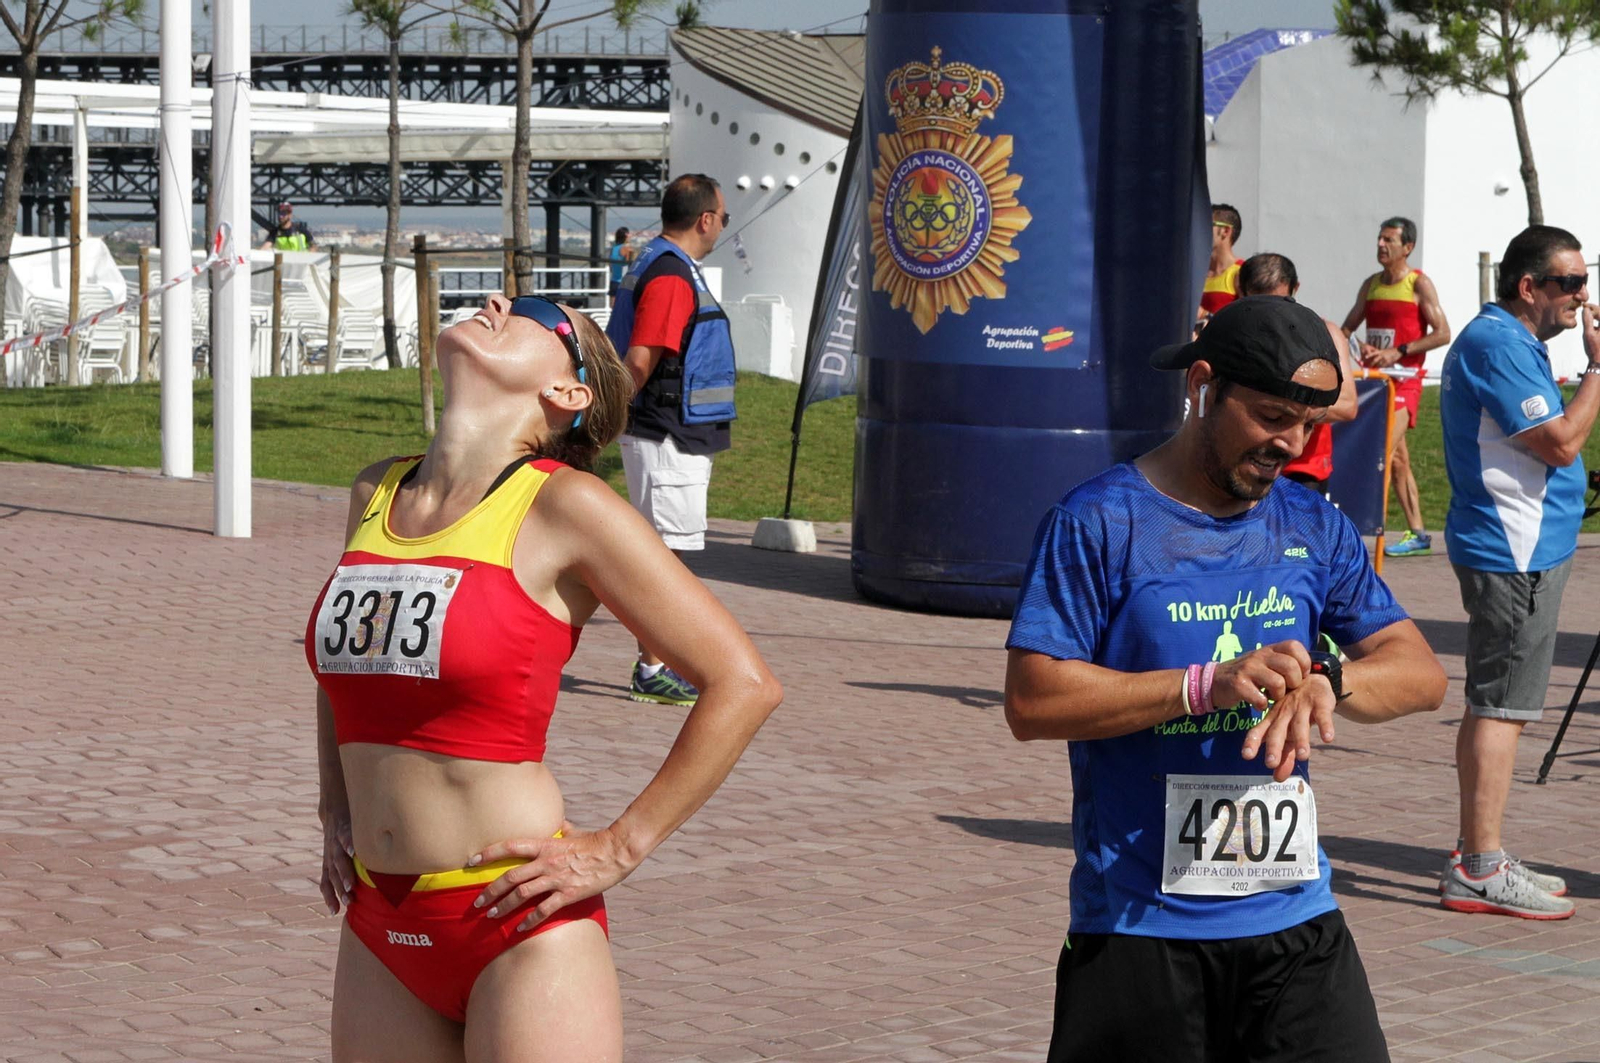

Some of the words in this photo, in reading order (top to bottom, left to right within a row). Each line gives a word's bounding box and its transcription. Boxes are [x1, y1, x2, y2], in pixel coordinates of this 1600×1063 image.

[924, 154, 986, 220] NACIONAL
[885, 226, 931, 275] AGRUPACIÓN
[932, 230, 983, 275] DEPORTIVA
[982, 324, 1039, 337] Agrupación
[986, 338, 1034, 351] Deportiva
[415, 575, 443, 585] POLICÍA
[1167, 602, 1192, 622] 10
[1195, 602, 1227, 621] km
[1230, 586, 1296, 620] Huelva
[323, 589, 437, 659] 3313
[375, 661, 435, 677] DEPORTIVA
[1201, 712, 1221, 733] del
[1172, 781, 1211, 790] DIRECCIÓN
[1211, 783, 1244, 791] GENERAL
[1268, 784, 1296, 792] POLICÍA
[1178, 798, 1299, 862] 4202
[1169, 865, 1244, 878] AGRUPACIÓN
[1247, 866, 1304, 878] DEPORTIVA
[1231, 882, 1249, 891] 4202
